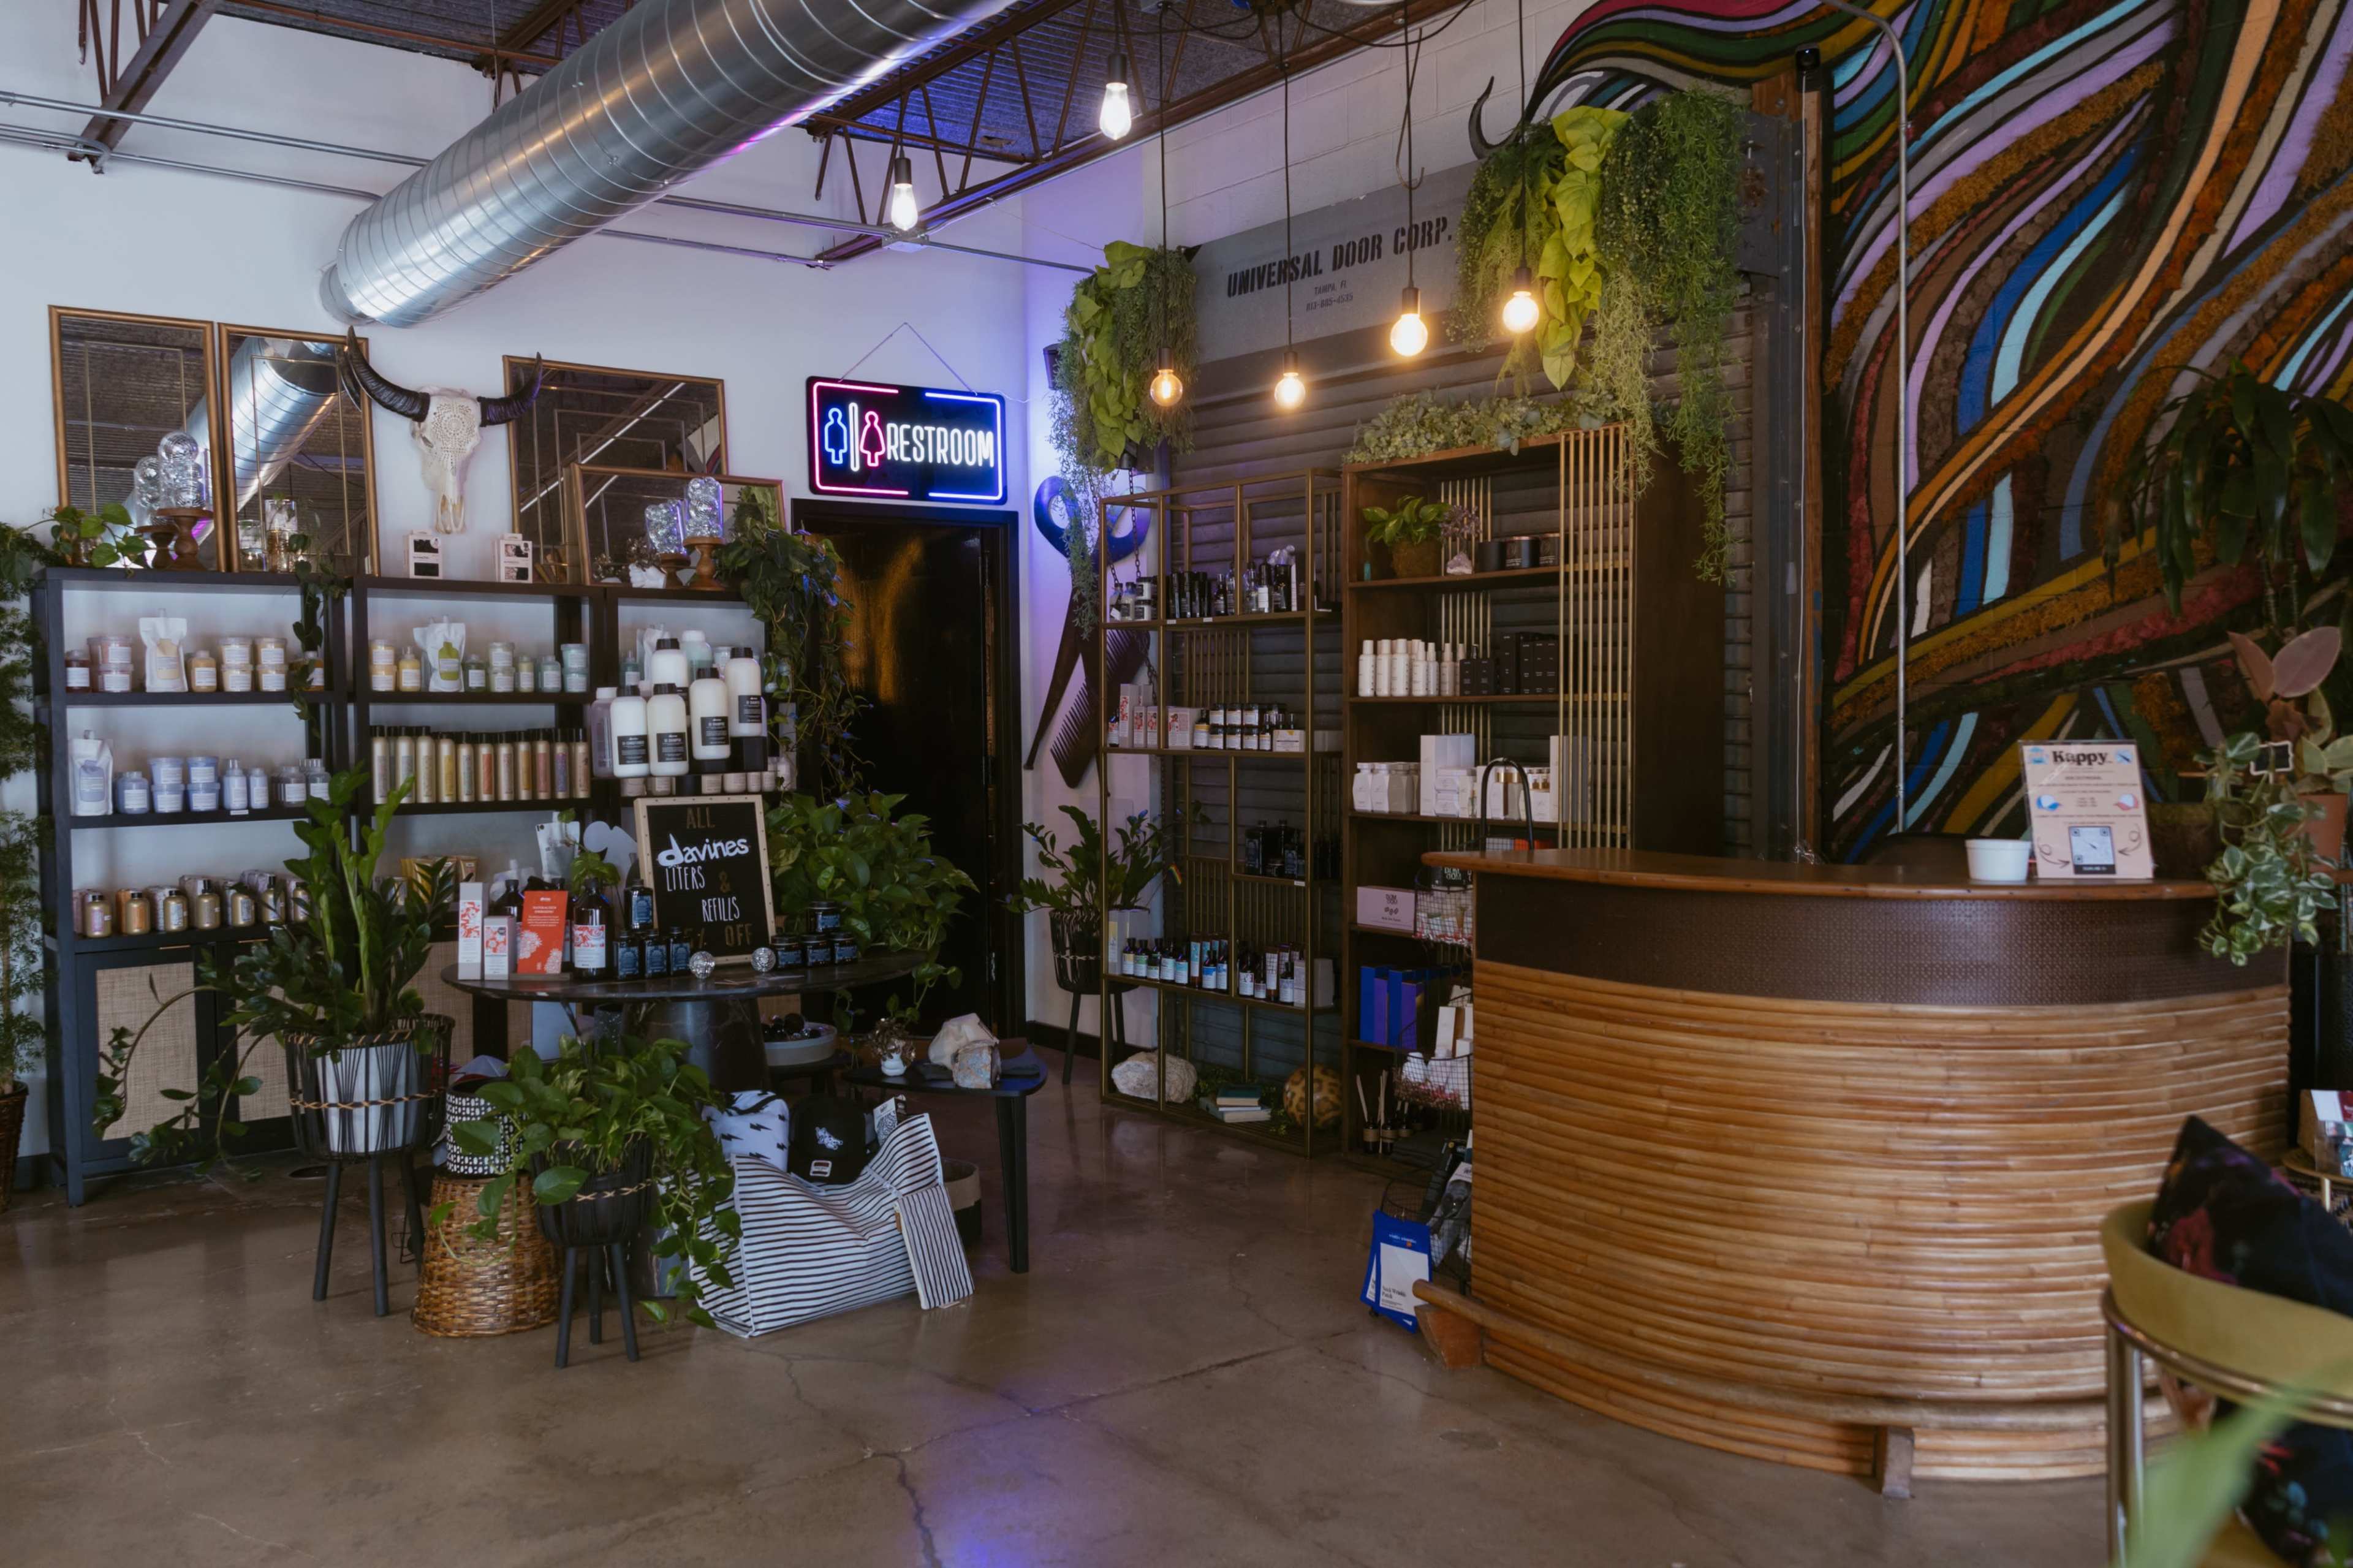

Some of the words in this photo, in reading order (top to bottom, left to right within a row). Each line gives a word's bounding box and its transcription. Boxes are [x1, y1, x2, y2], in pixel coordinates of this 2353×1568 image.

[1227, 250, 1323, 298] UNIVERSAL
[1332, 233, 1382, 271] DOOR
[1393, 216, 1452, 256] CORP.
[886, 423, 995, 468] RESTROOM
[2052, 751, 2108, 766] Kappy
[686, 807, 716, 829] ALL
[657, 833, 750, 867] davines
[665, 866, 705, 892] LITERS
[718, 871, 732, 893] &
[702, 896, 740, 923] REFILLS
[725, 923, 753, 947] OFF
